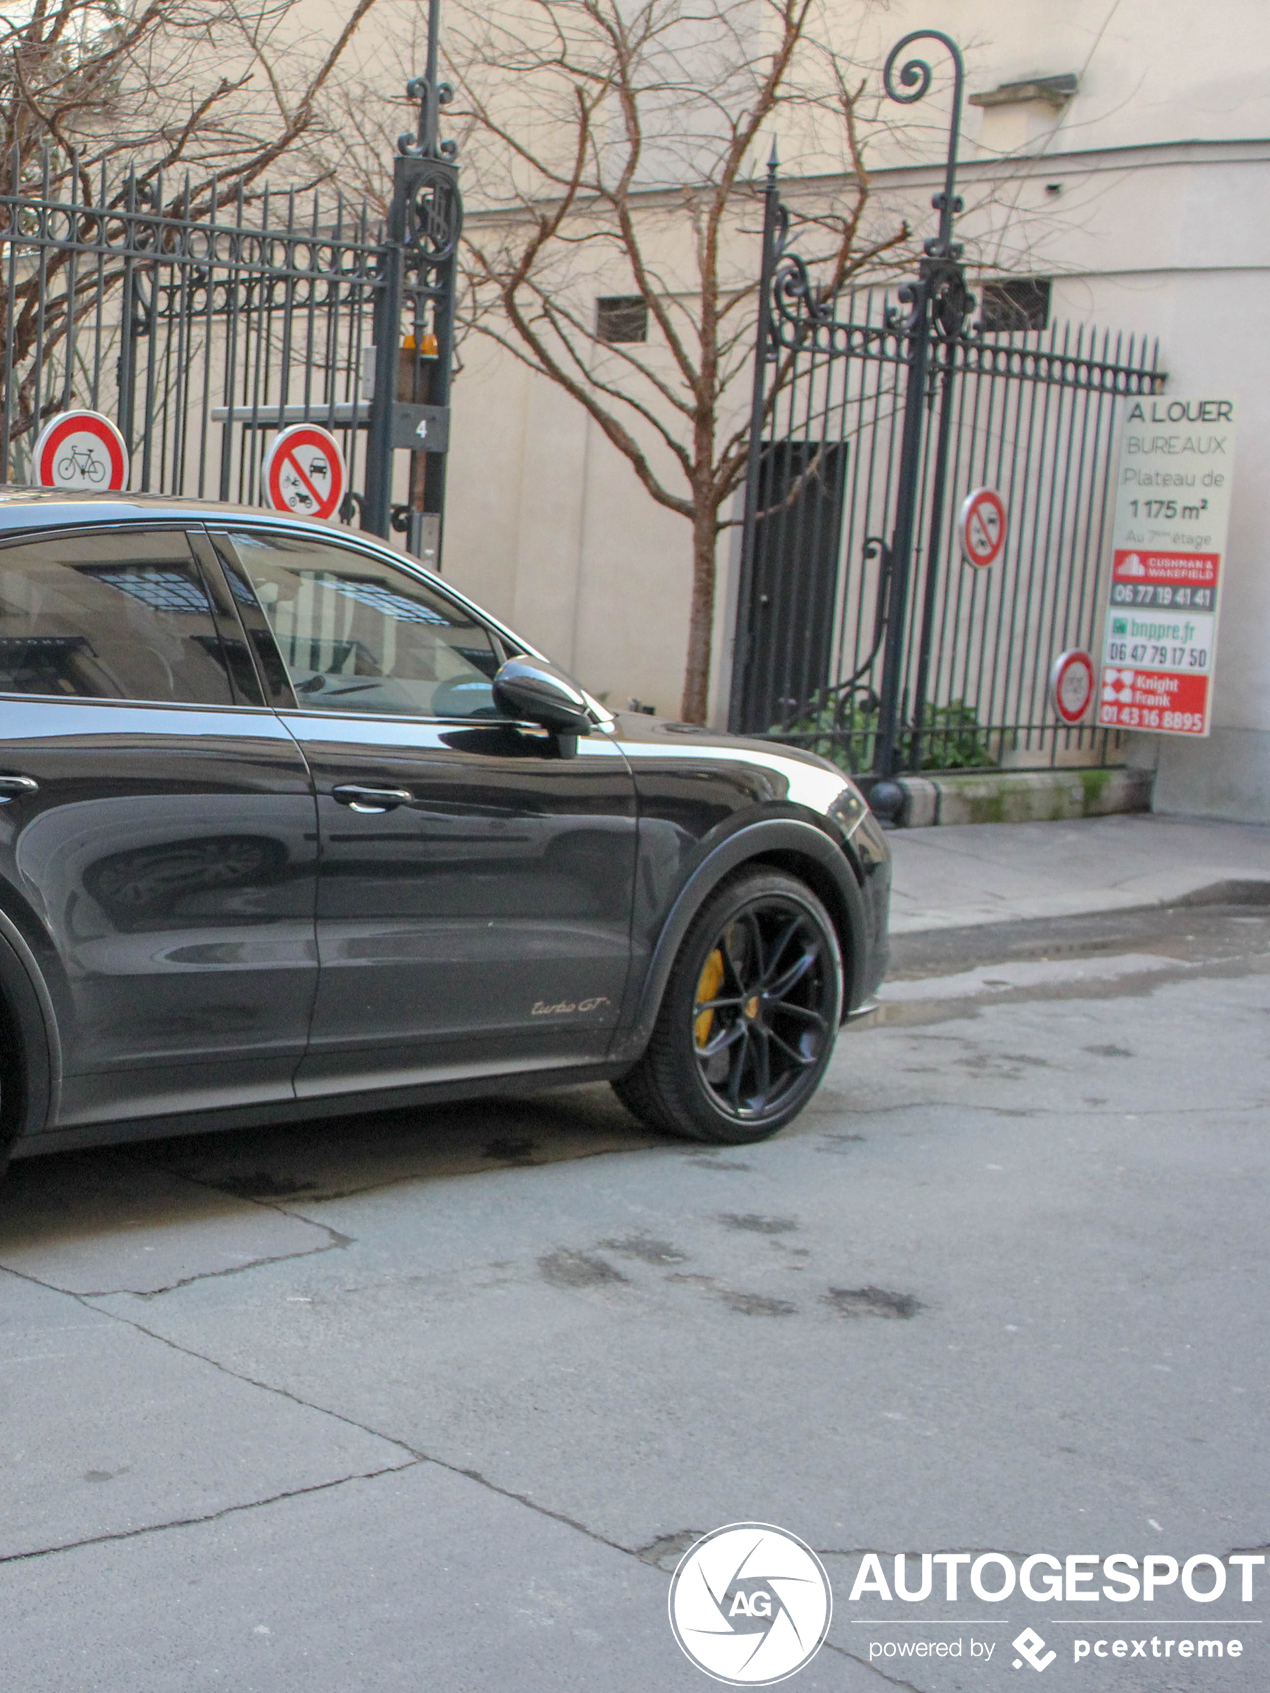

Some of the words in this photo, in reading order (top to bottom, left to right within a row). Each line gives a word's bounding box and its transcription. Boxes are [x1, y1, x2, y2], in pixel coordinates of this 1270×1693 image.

[1128, 402, 1145, 422] A
[1152, 401, 1234, 422] LOUER
[415, 419, 428, 439] 4
[1127, 436, 1227, 455] BUREAUX
[1123, 467, 1196, 487] Plateau
[1202, 470, 1225, 487] de
[1125, 530, 1144, 542] Au
[1172, 531, 1212, 549] étage
[1149, 557, 1201, 569] CUSHMAN
[1205, 560, 1214, 569] &
[1148, 567, 1214, 580] WAKEFIELD
[1114, 584, 1133, 602] 06
[1136, 586, 1154, 603] 77
[1156, 587, 1172, 605] 19
[1175, 588, 1191, 605] 41
[1194, 589, 1210, 606] 41
[1131, 618, 1196, 644] bnppre.fr
[1109, 642, 1127, 661] 06
[1131, 644, 1147, 663] 47
[1151, 645, 1168, 664] 79
[1171, 647, 1186, 666] 17
[1189, 648, 1207, 668] 50
[1136, 675, 1180, 694] Knight
[1135, 690, 1171, 707] Frank
[1102, 705, 1118, 722] 01
[1120, 707, 1140, 725] 43
[1142, 709, 1160, 727] 16
[1162, 710, 1203, 731] 8895
[577, 997, 608, 1012] GT
